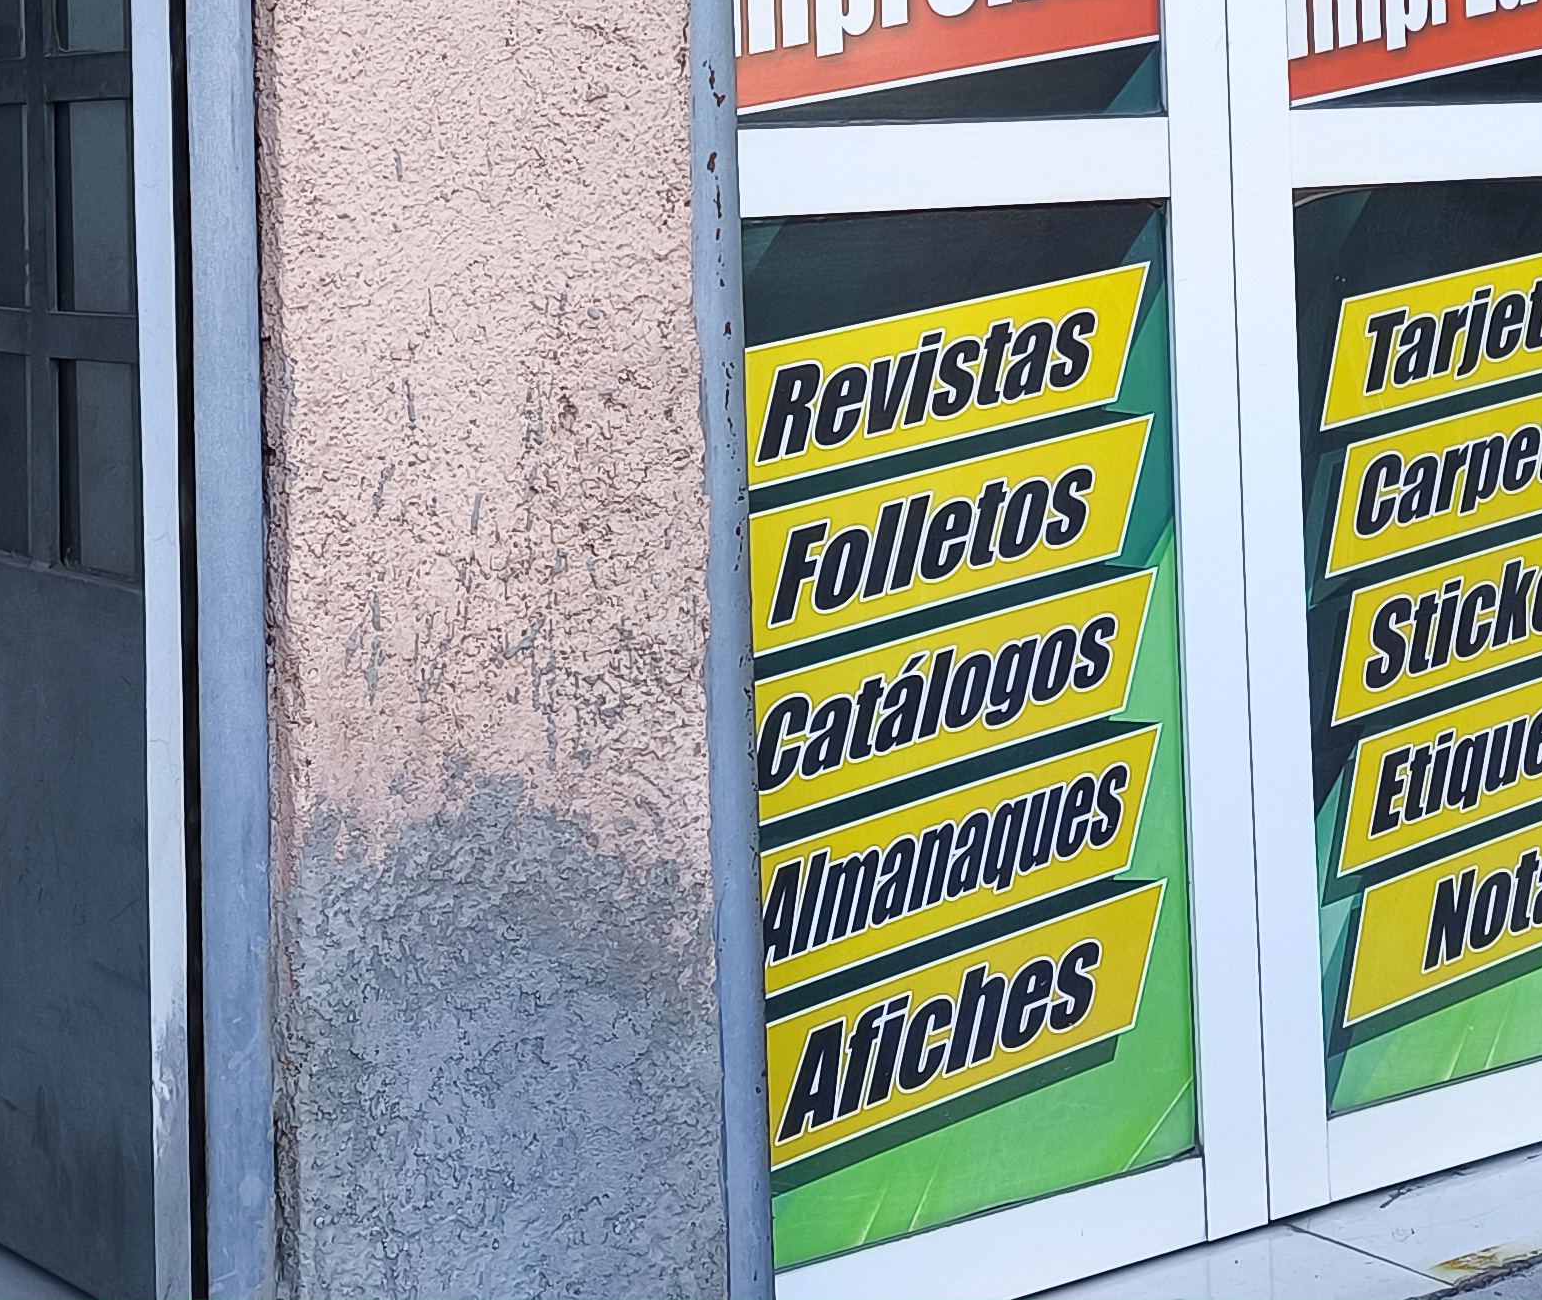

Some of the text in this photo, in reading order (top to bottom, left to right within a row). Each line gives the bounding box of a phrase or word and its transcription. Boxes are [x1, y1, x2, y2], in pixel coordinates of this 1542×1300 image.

[757, 310, 1097, 464] Revistas
[769, 466, 1094, 627] Folletos
[758, 614, 1117, 792] Catálogos
[762, 764, 1128, 965] Almanaques
[776, 939, 1101, 1144] Afiches
